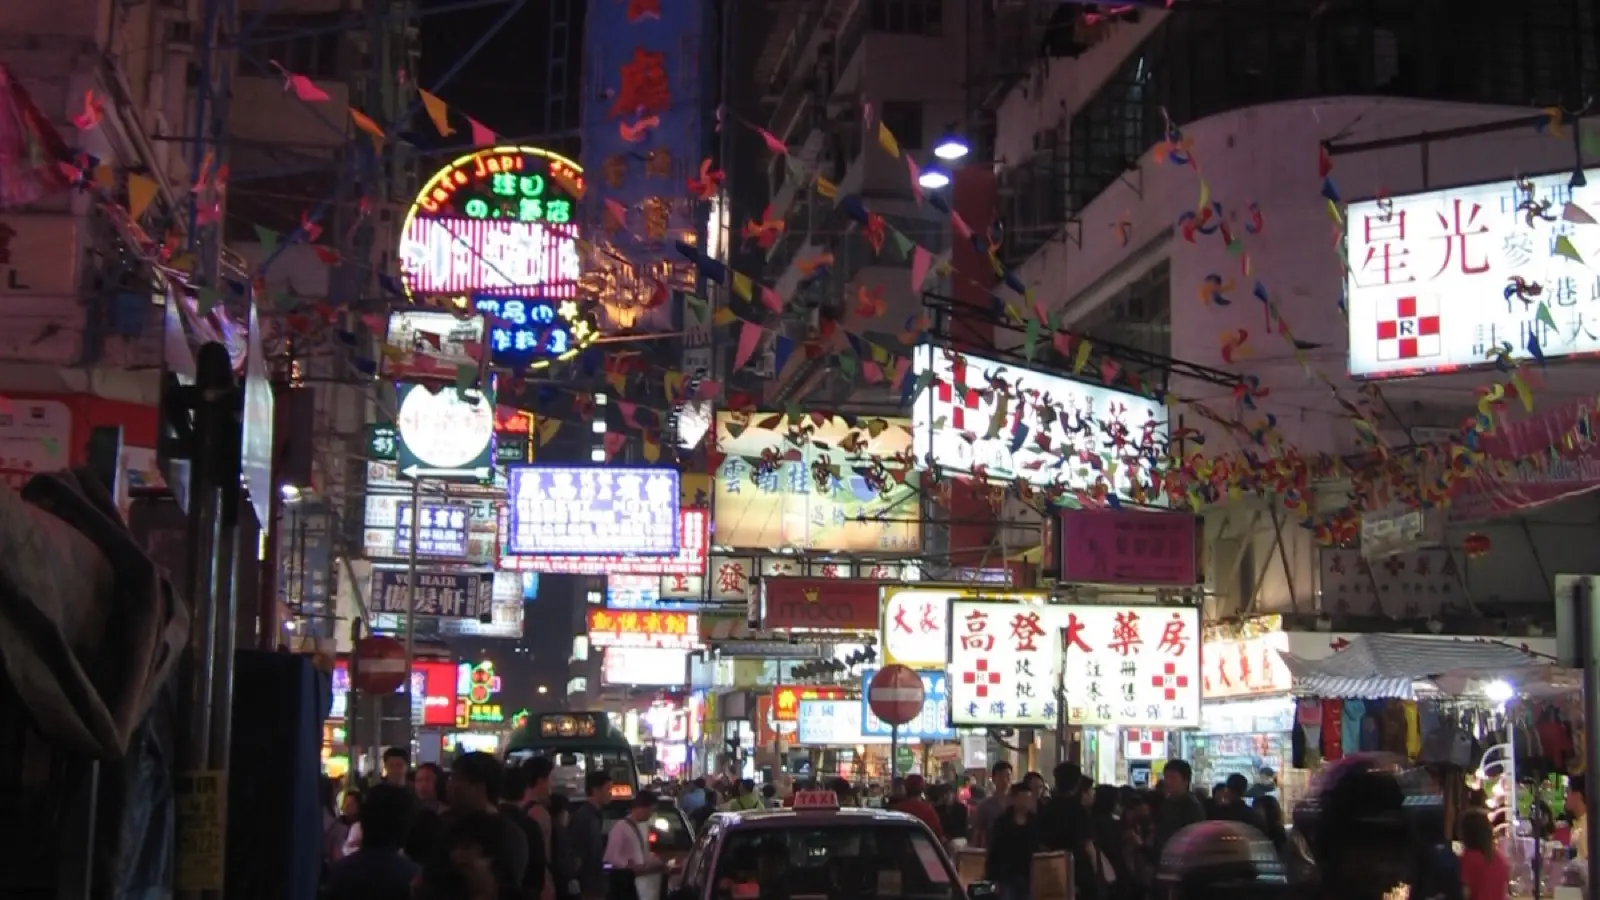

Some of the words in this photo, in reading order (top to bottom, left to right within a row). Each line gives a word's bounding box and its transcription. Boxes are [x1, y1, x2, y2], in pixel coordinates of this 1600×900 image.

[420, 170, 467, 212] Cafe
[1361, 198, 1490, 285] 星光
[1399, 320, 1414, 335] R
[420, 575, 457, 588] HAIR
[779, 600, 855, 621] moca
[893, 602, 940, 634] 大家
[960, 609, 1190, 656] 高登大藥房
[799, 793, 835, 805] TAXI
